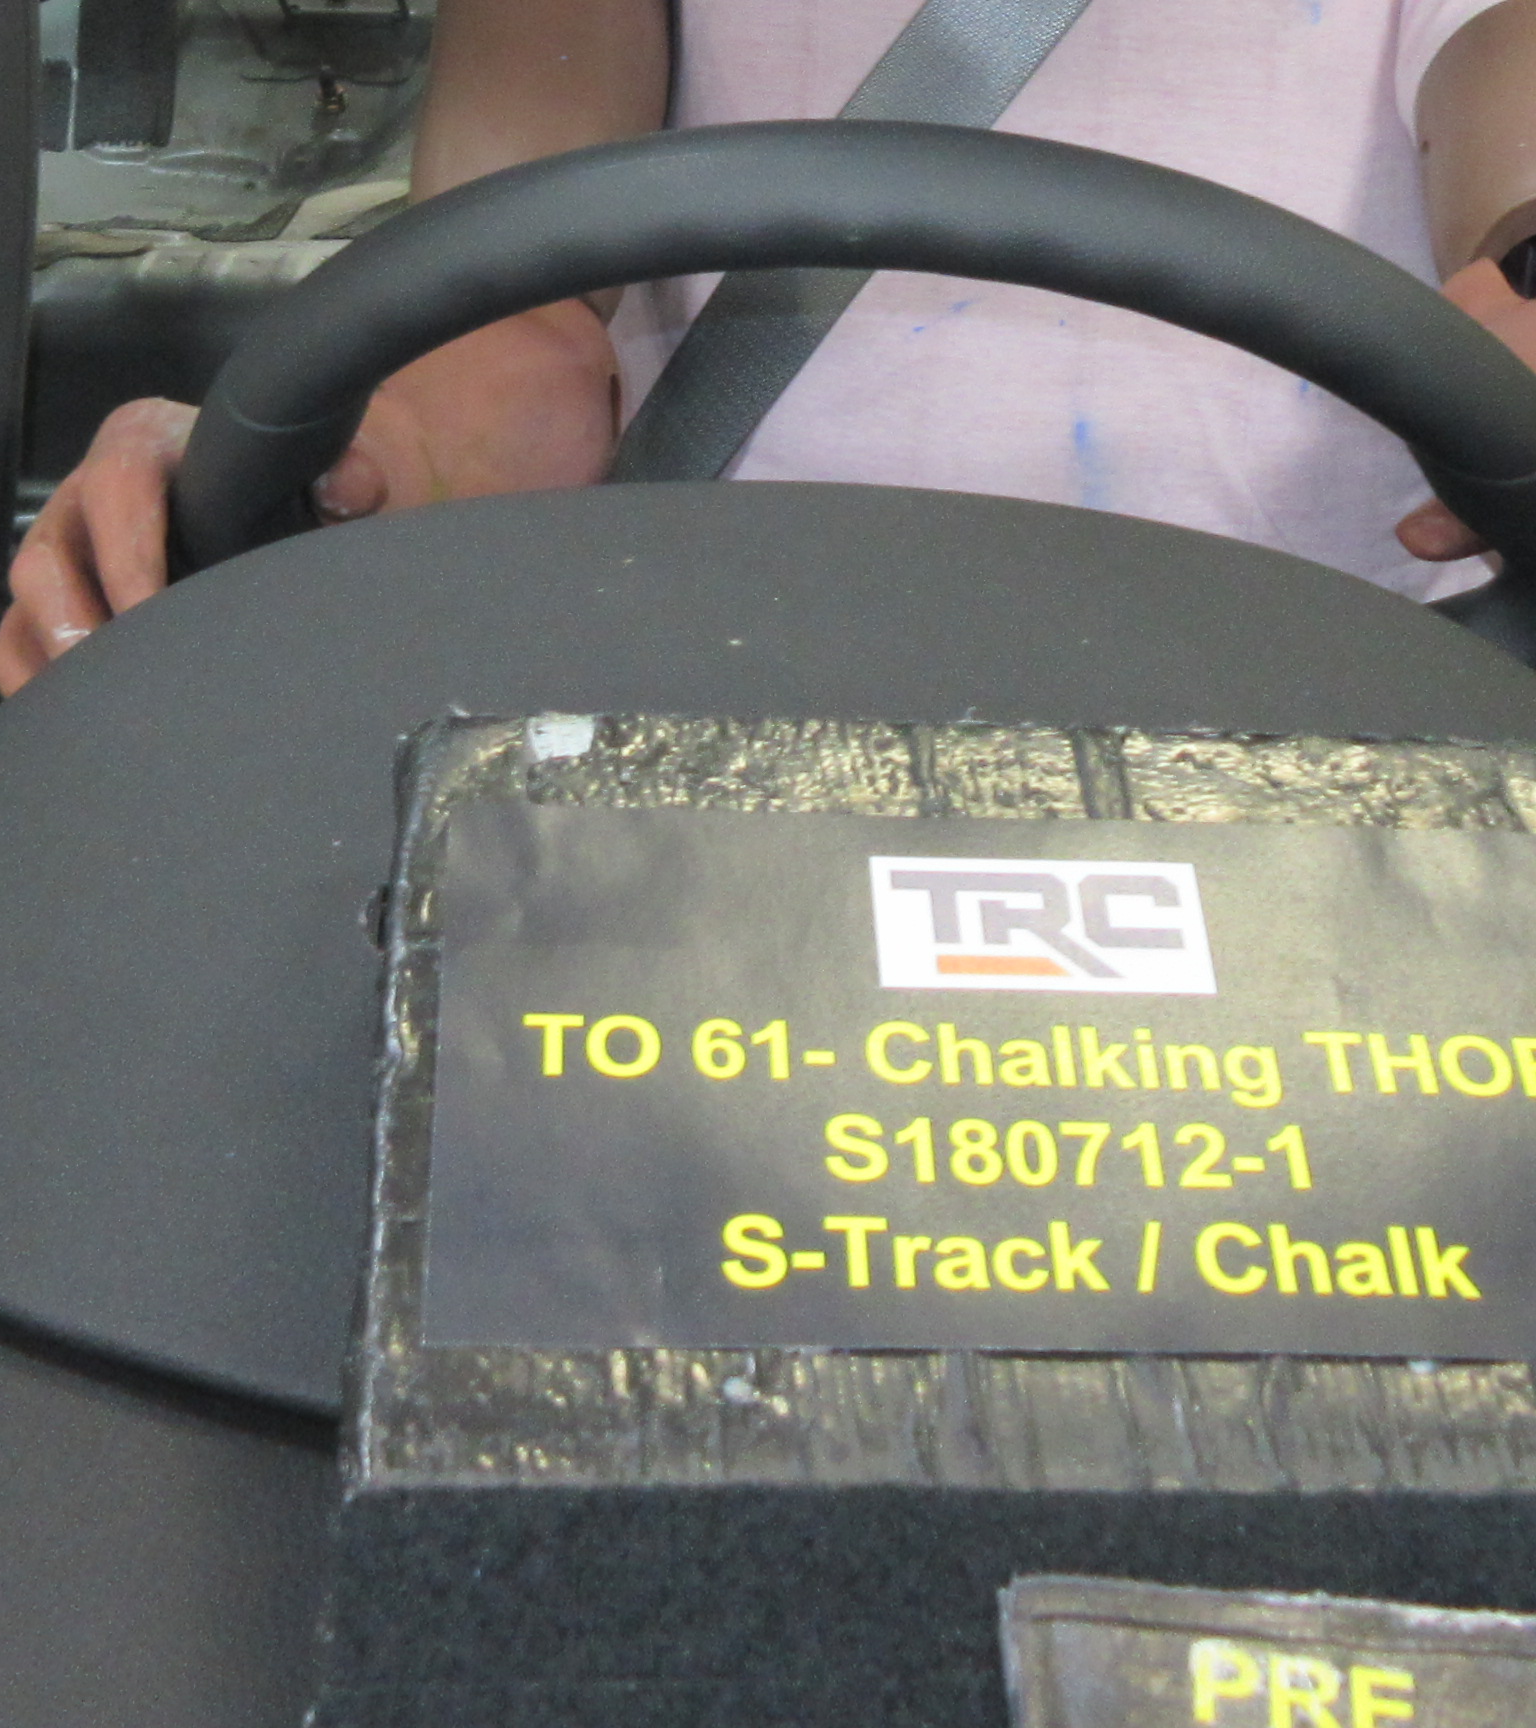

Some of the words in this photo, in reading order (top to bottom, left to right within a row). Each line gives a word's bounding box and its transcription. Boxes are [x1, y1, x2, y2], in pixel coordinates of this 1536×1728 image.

[889, 868, 1187, 979] TRC
[521, 1012, 663, 1080] TO
[690, 1016, 837, 1082] 61-
[864, 1019, 1285, 1110] Chalking
[823, 1112, 1314, 1191] S180712-1
[720, 1211, 1112, 1294] S-Track
[1136, 1220, 1163, 1295] /
[1193, 1221, 1483, 1301] Chalk
